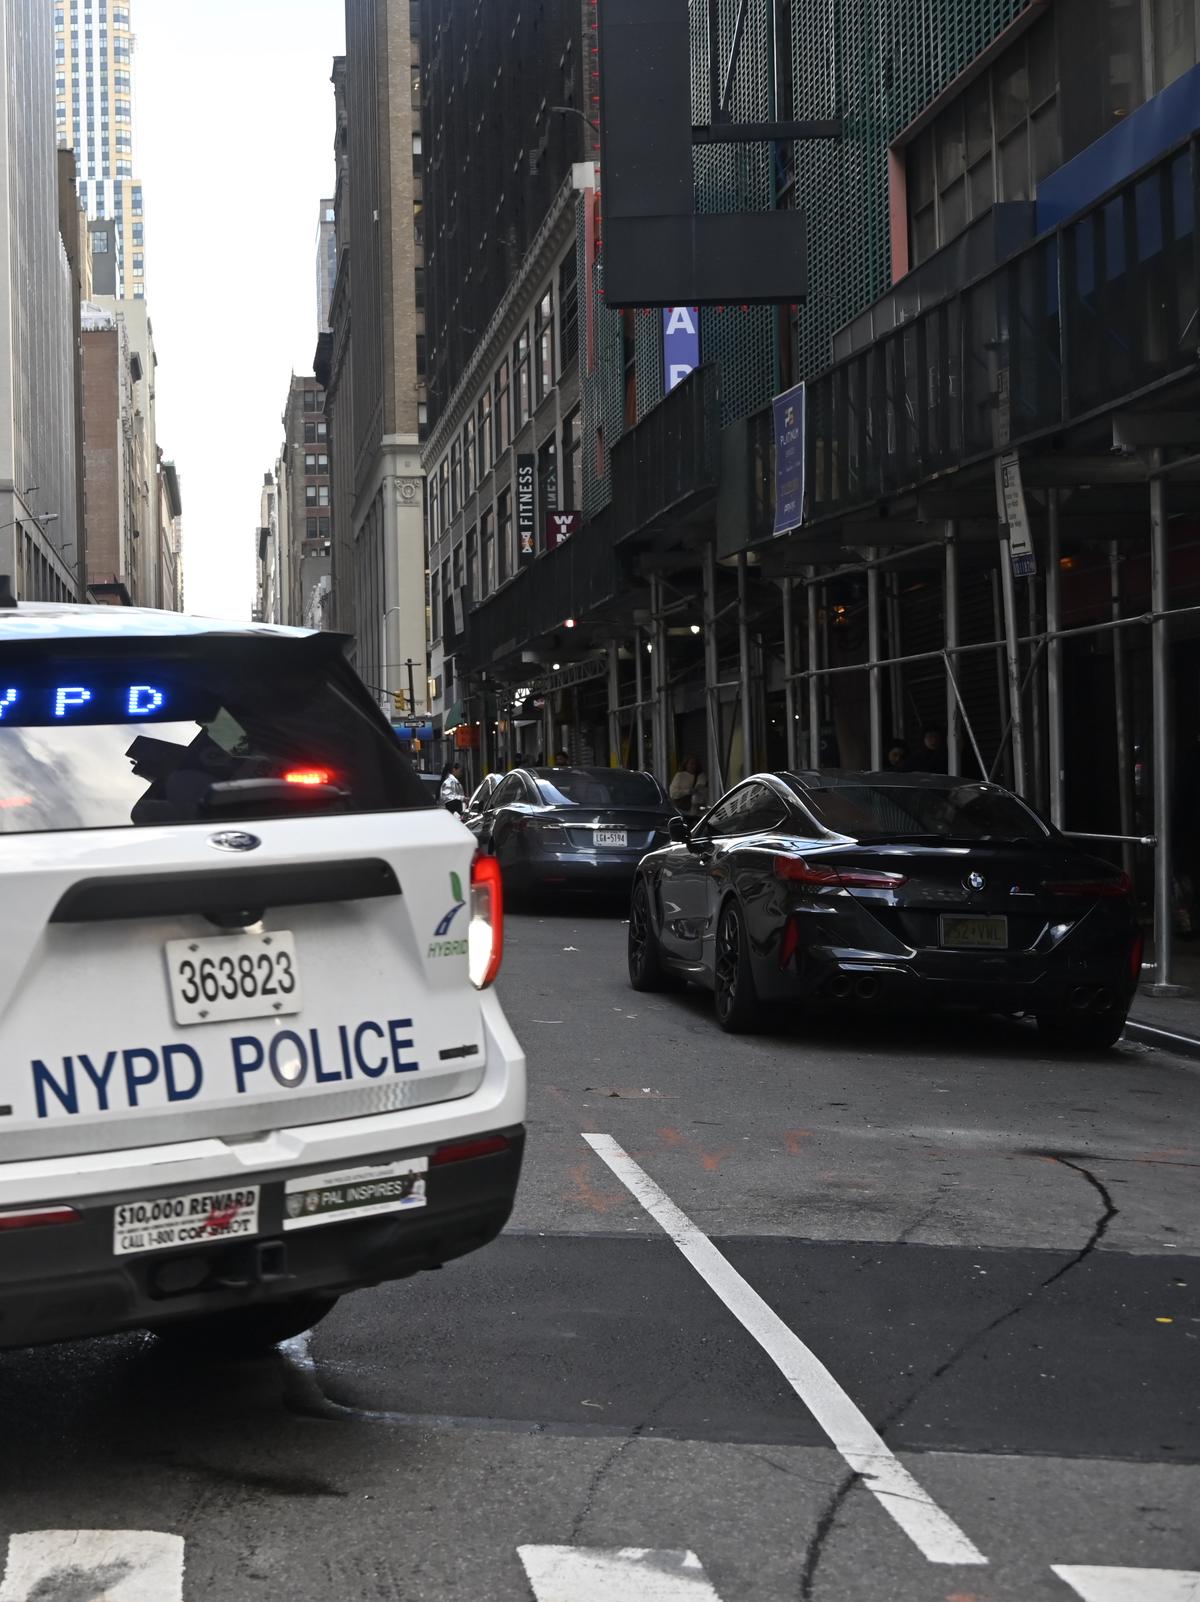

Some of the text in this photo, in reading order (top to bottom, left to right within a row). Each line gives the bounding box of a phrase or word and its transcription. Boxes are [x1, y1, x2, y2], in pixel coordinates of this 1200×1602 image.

[519, 466, 533, 526] FITNESS
[427, 939, 470, 959] HYBRID
[179, 951, 296, 1005] 363823
[31, 1018, 419, 1118] NYPD POLICE
[118, 1199, 185, 1228] $10,000
[190, 1190, 256, 1216] REWARD
[320, 1180, 403, 1206] PAL INSPIRES
[121, 1232, 145, 1250] CALL
